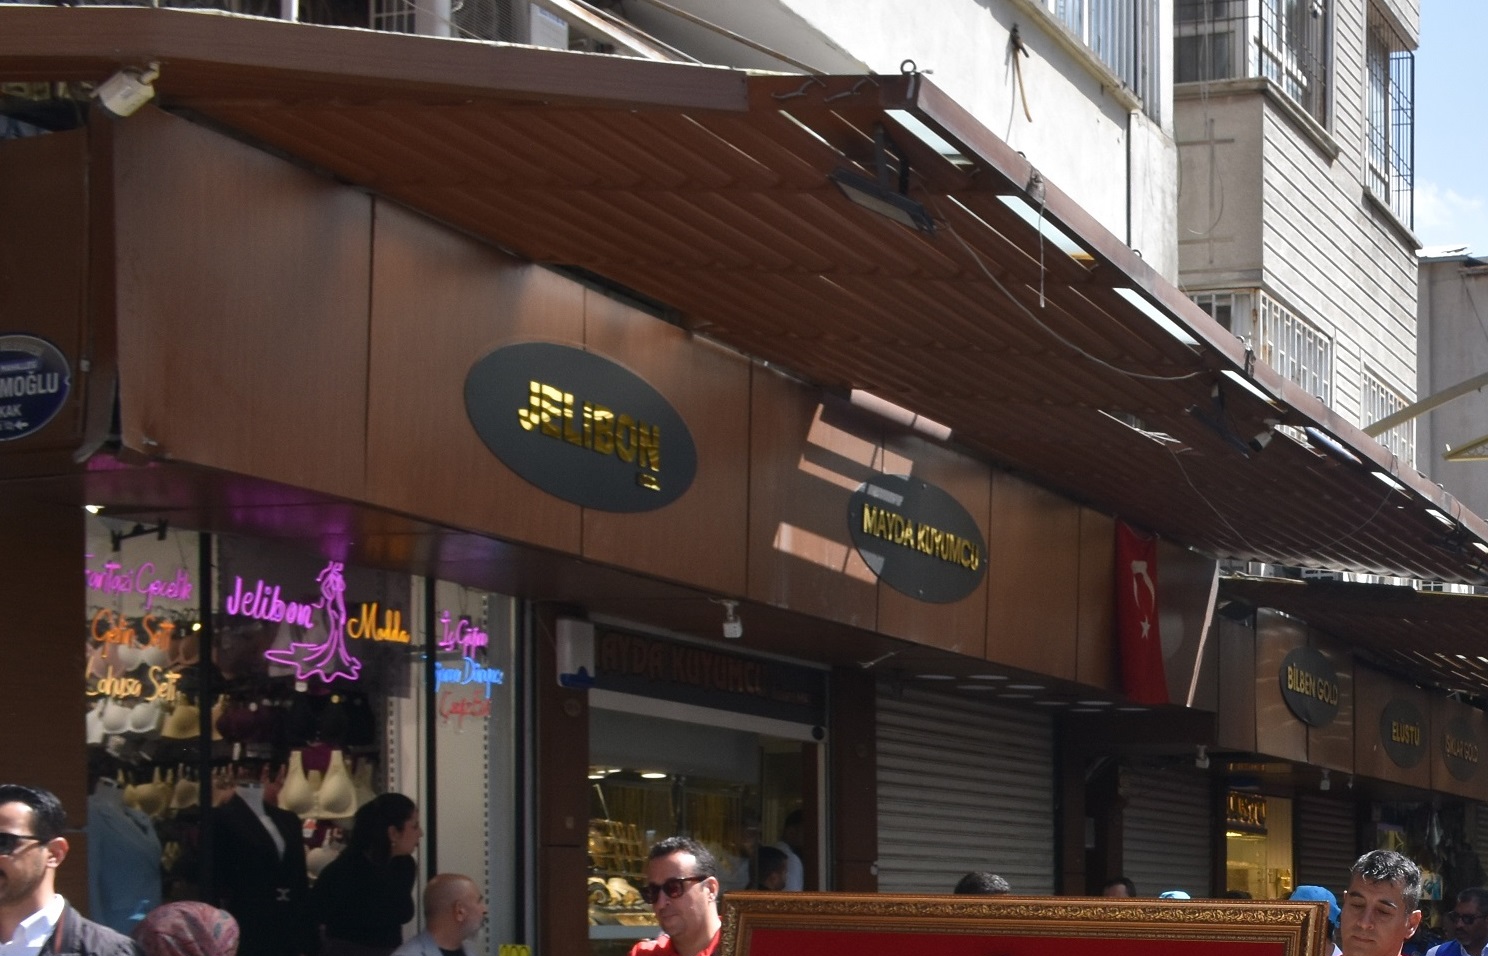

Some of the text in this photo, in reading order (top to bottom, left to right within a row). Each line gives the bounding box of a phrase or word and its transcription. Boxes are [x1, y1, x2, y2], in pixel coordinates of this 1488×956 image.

[863, 502, 981, 571] MAYDA KUYUMCU
[226, 575, 314, 630] Jelibon
[1287, 662, 1338, 706] BİLBEN GOLD
